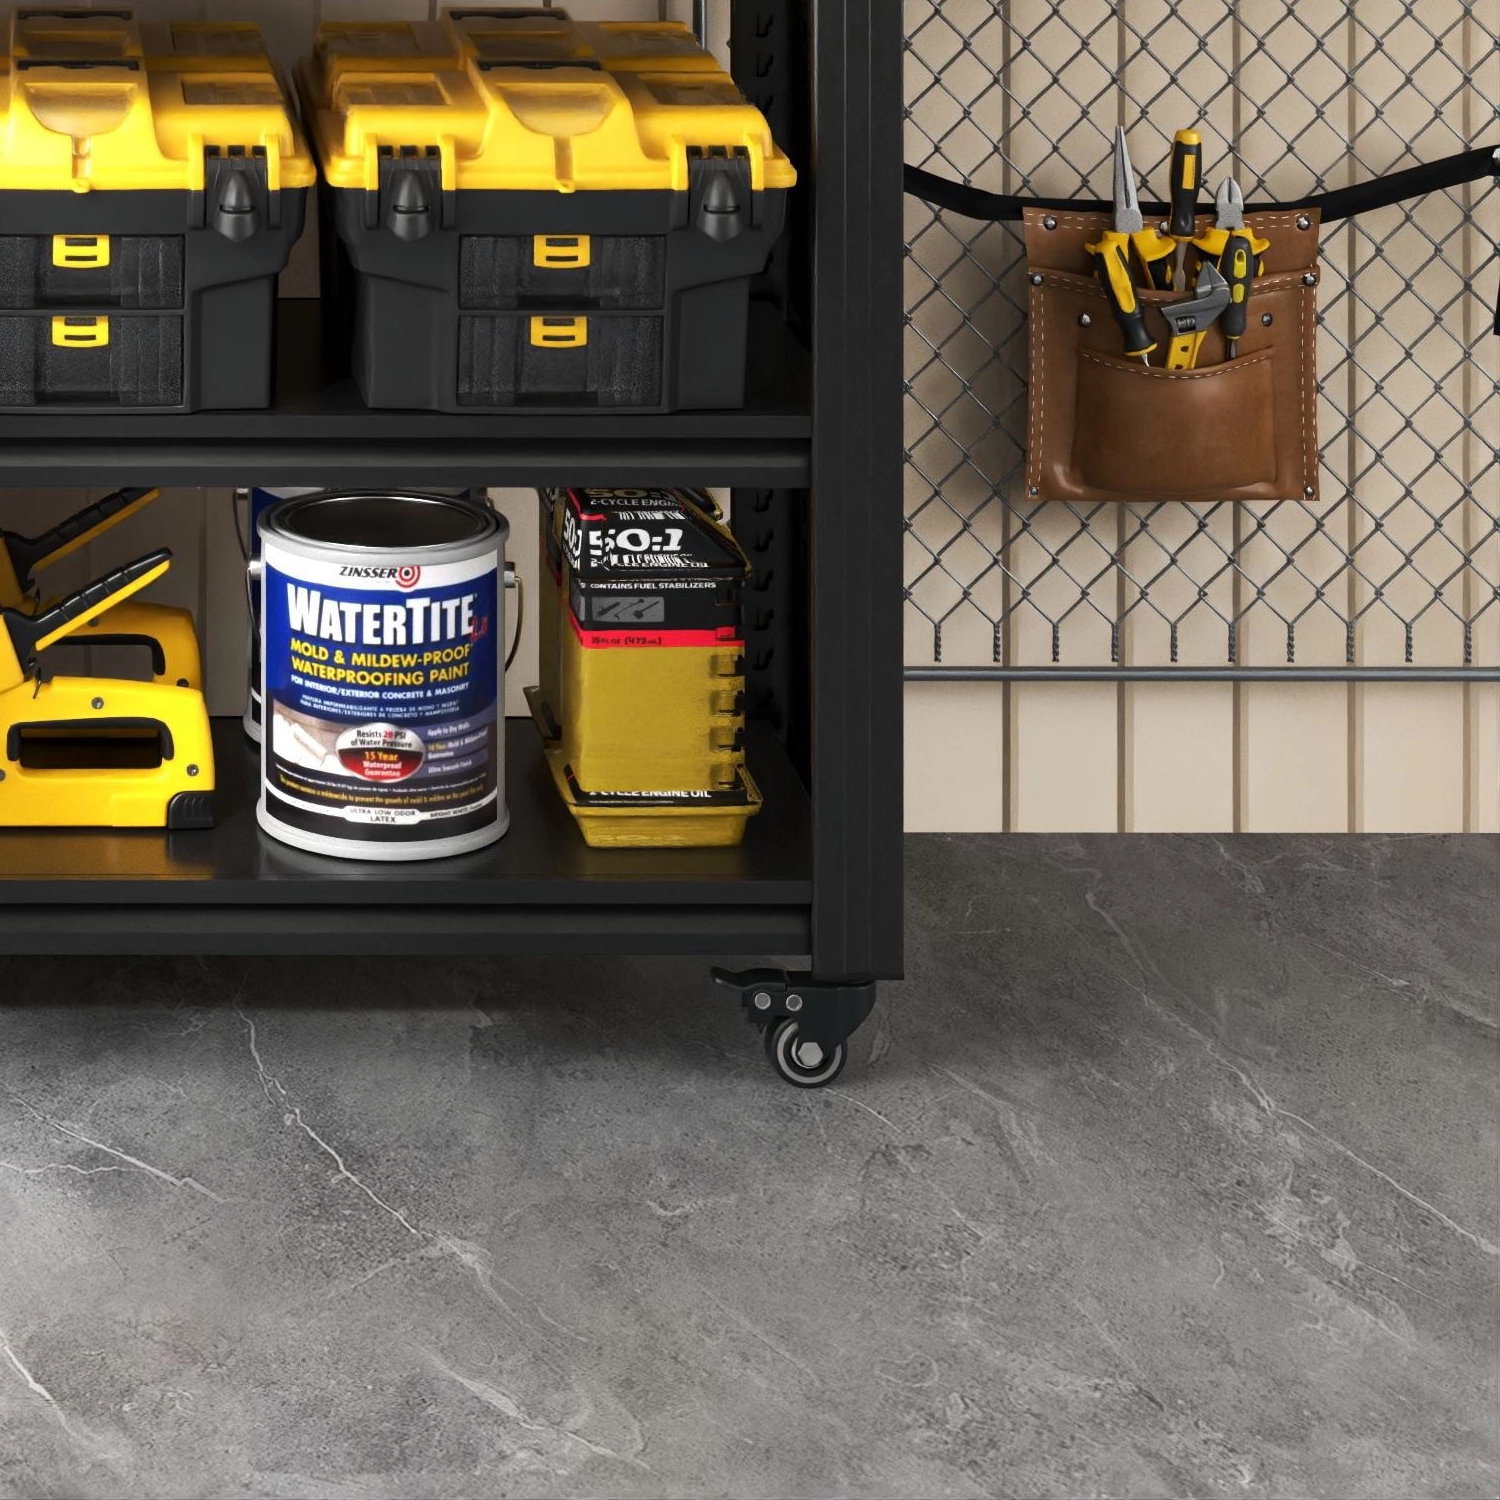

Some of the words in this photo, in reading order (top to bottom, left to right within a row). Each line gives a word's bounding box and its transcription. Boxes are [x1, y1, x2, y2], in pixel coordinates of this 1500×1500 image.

[590, 498, 639, 506] 2-CYCLE
[339, 566, 398, 579] ZINSSER
[659, 581, 716, 589] STABILIZERS
[291, 638, 329, 661] MOLD
[333, 650, 346, 665] &
[351, 643, 471, 669] MILDEW-PROOF
[291, 656, 424, 687] WATERPROOFING
[429, 662, 470, 683] PAINT
[291, 674, 304, 687] FOR
[304, 679, 380, 699] INTERIOR/EXTERIOR
[382, 690, 424, 700] CONCRETE
[434, 682, 470, 696] MASONRY
[356, 730, 382, 738] Resists
[383, 730, 393, 739] 20
[394, 731, 407, 740] PSI
[350, 739, 358, 747] of
[359, 739, 381, 747] Water
[382, 740, 412, 748] Pressure
[364, 751, 377, 760] 15
[377, 751, 399, 761] Year
[363, 760, 402, 770] Waterproof
[364, 768, 401, 777] Guarantee
[690, 790, 712, 798] OIL
[349, 807, 371, 815] ULTRA
[369, 815, 396, 823] LATEX
